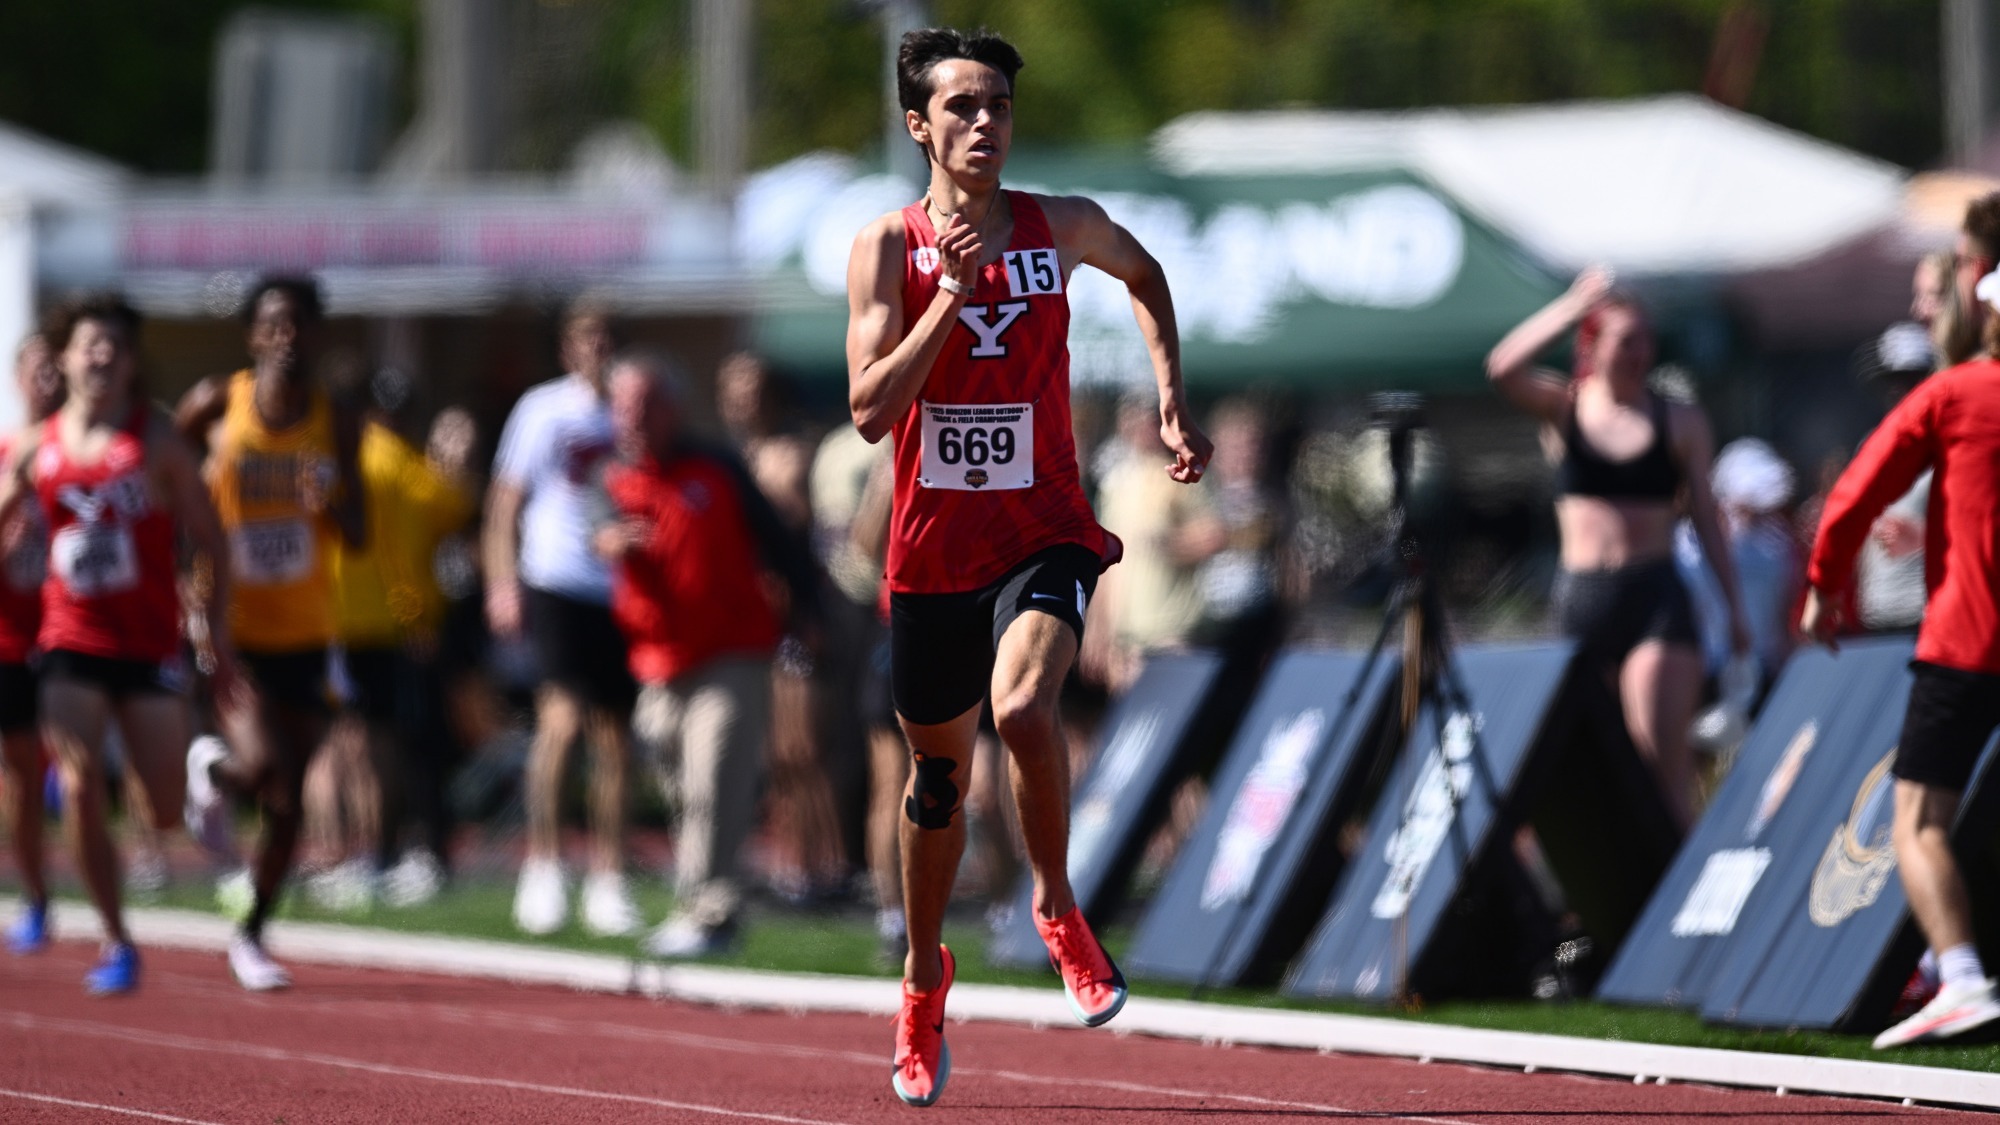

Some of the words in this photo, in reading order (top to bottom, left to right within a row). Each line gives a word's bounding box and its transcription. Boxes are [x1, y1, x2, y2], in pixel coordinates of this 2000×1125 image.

[1009, 251, 1055, 293] 15
[957, 301, 1030, 359] Y
[932, 415, 951, 423] TRACK
[974, 415, 1021, 423] CHAMPIONSHIP
[945, 407, 971, 415] HORIZON
[973, 407, 994, 415] LEAGUE
[995, 406, 1023, 414] OUTDOOR
[937, 426, 1016, 467] 669
